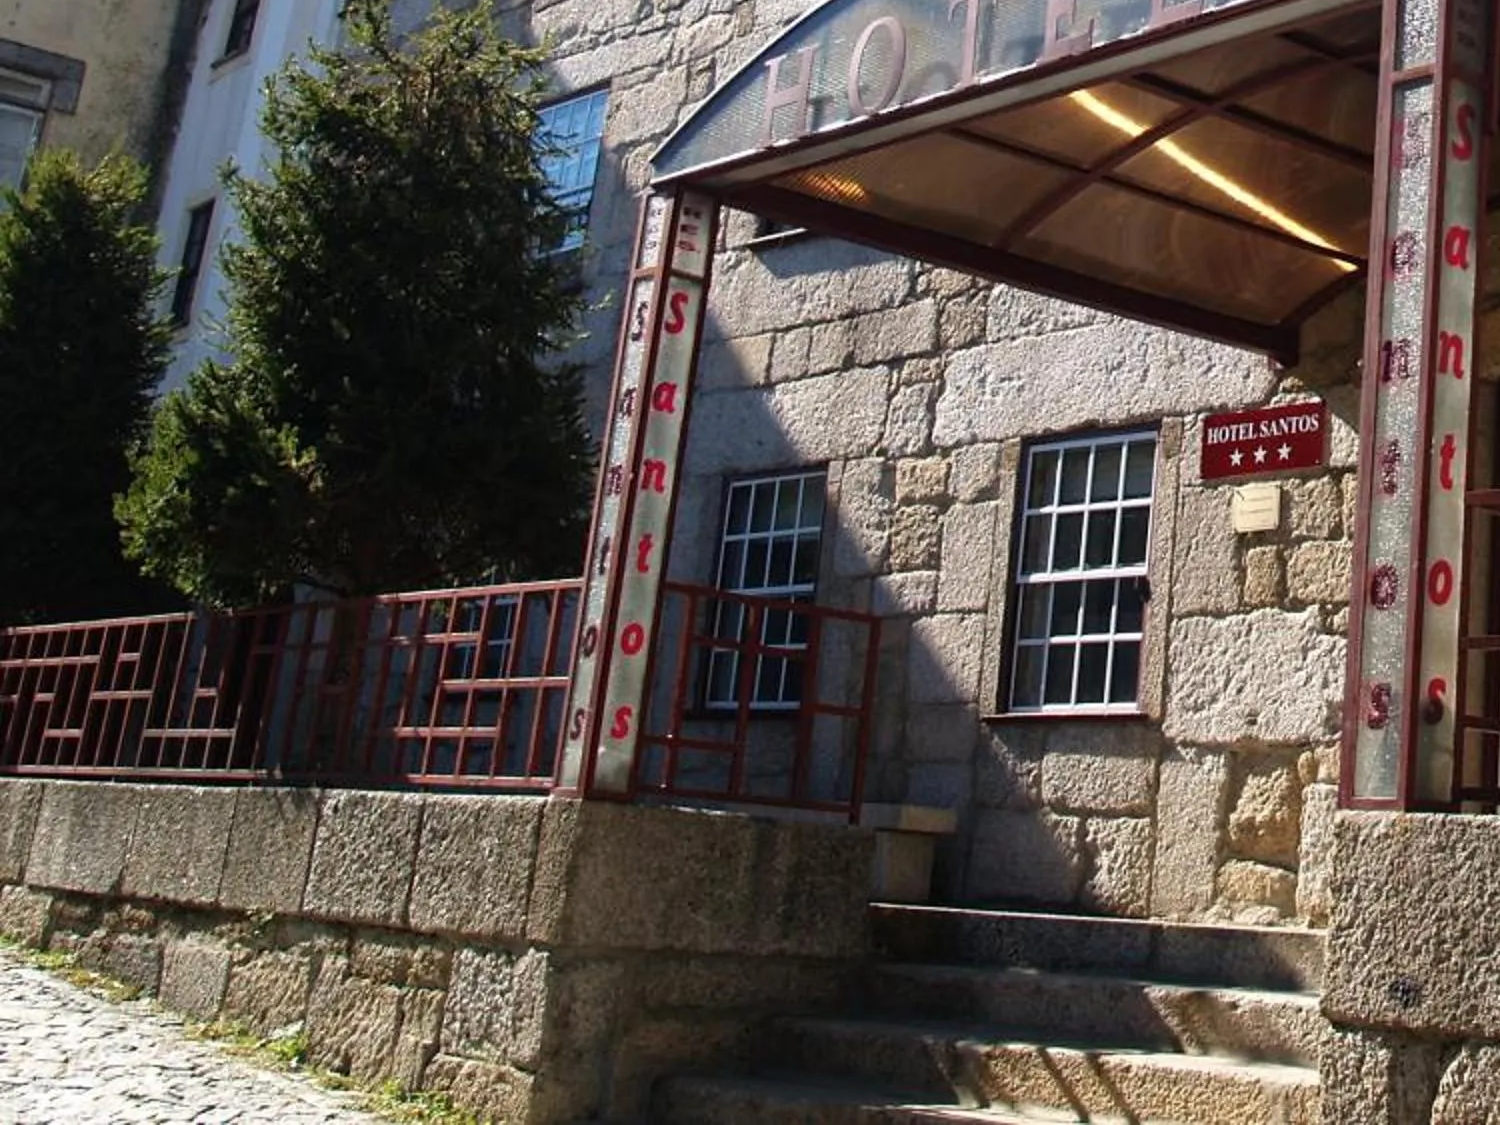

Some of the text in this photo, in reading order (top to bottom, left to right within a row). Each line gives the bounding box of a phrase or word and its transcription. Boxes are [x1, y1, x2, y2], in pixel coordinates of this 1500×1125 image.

[610, 291, 690, 740] Santos
[1207, 413, 1320, 445] HOTEL SANTOS
[1420, 103, 1477, 726] Santos
